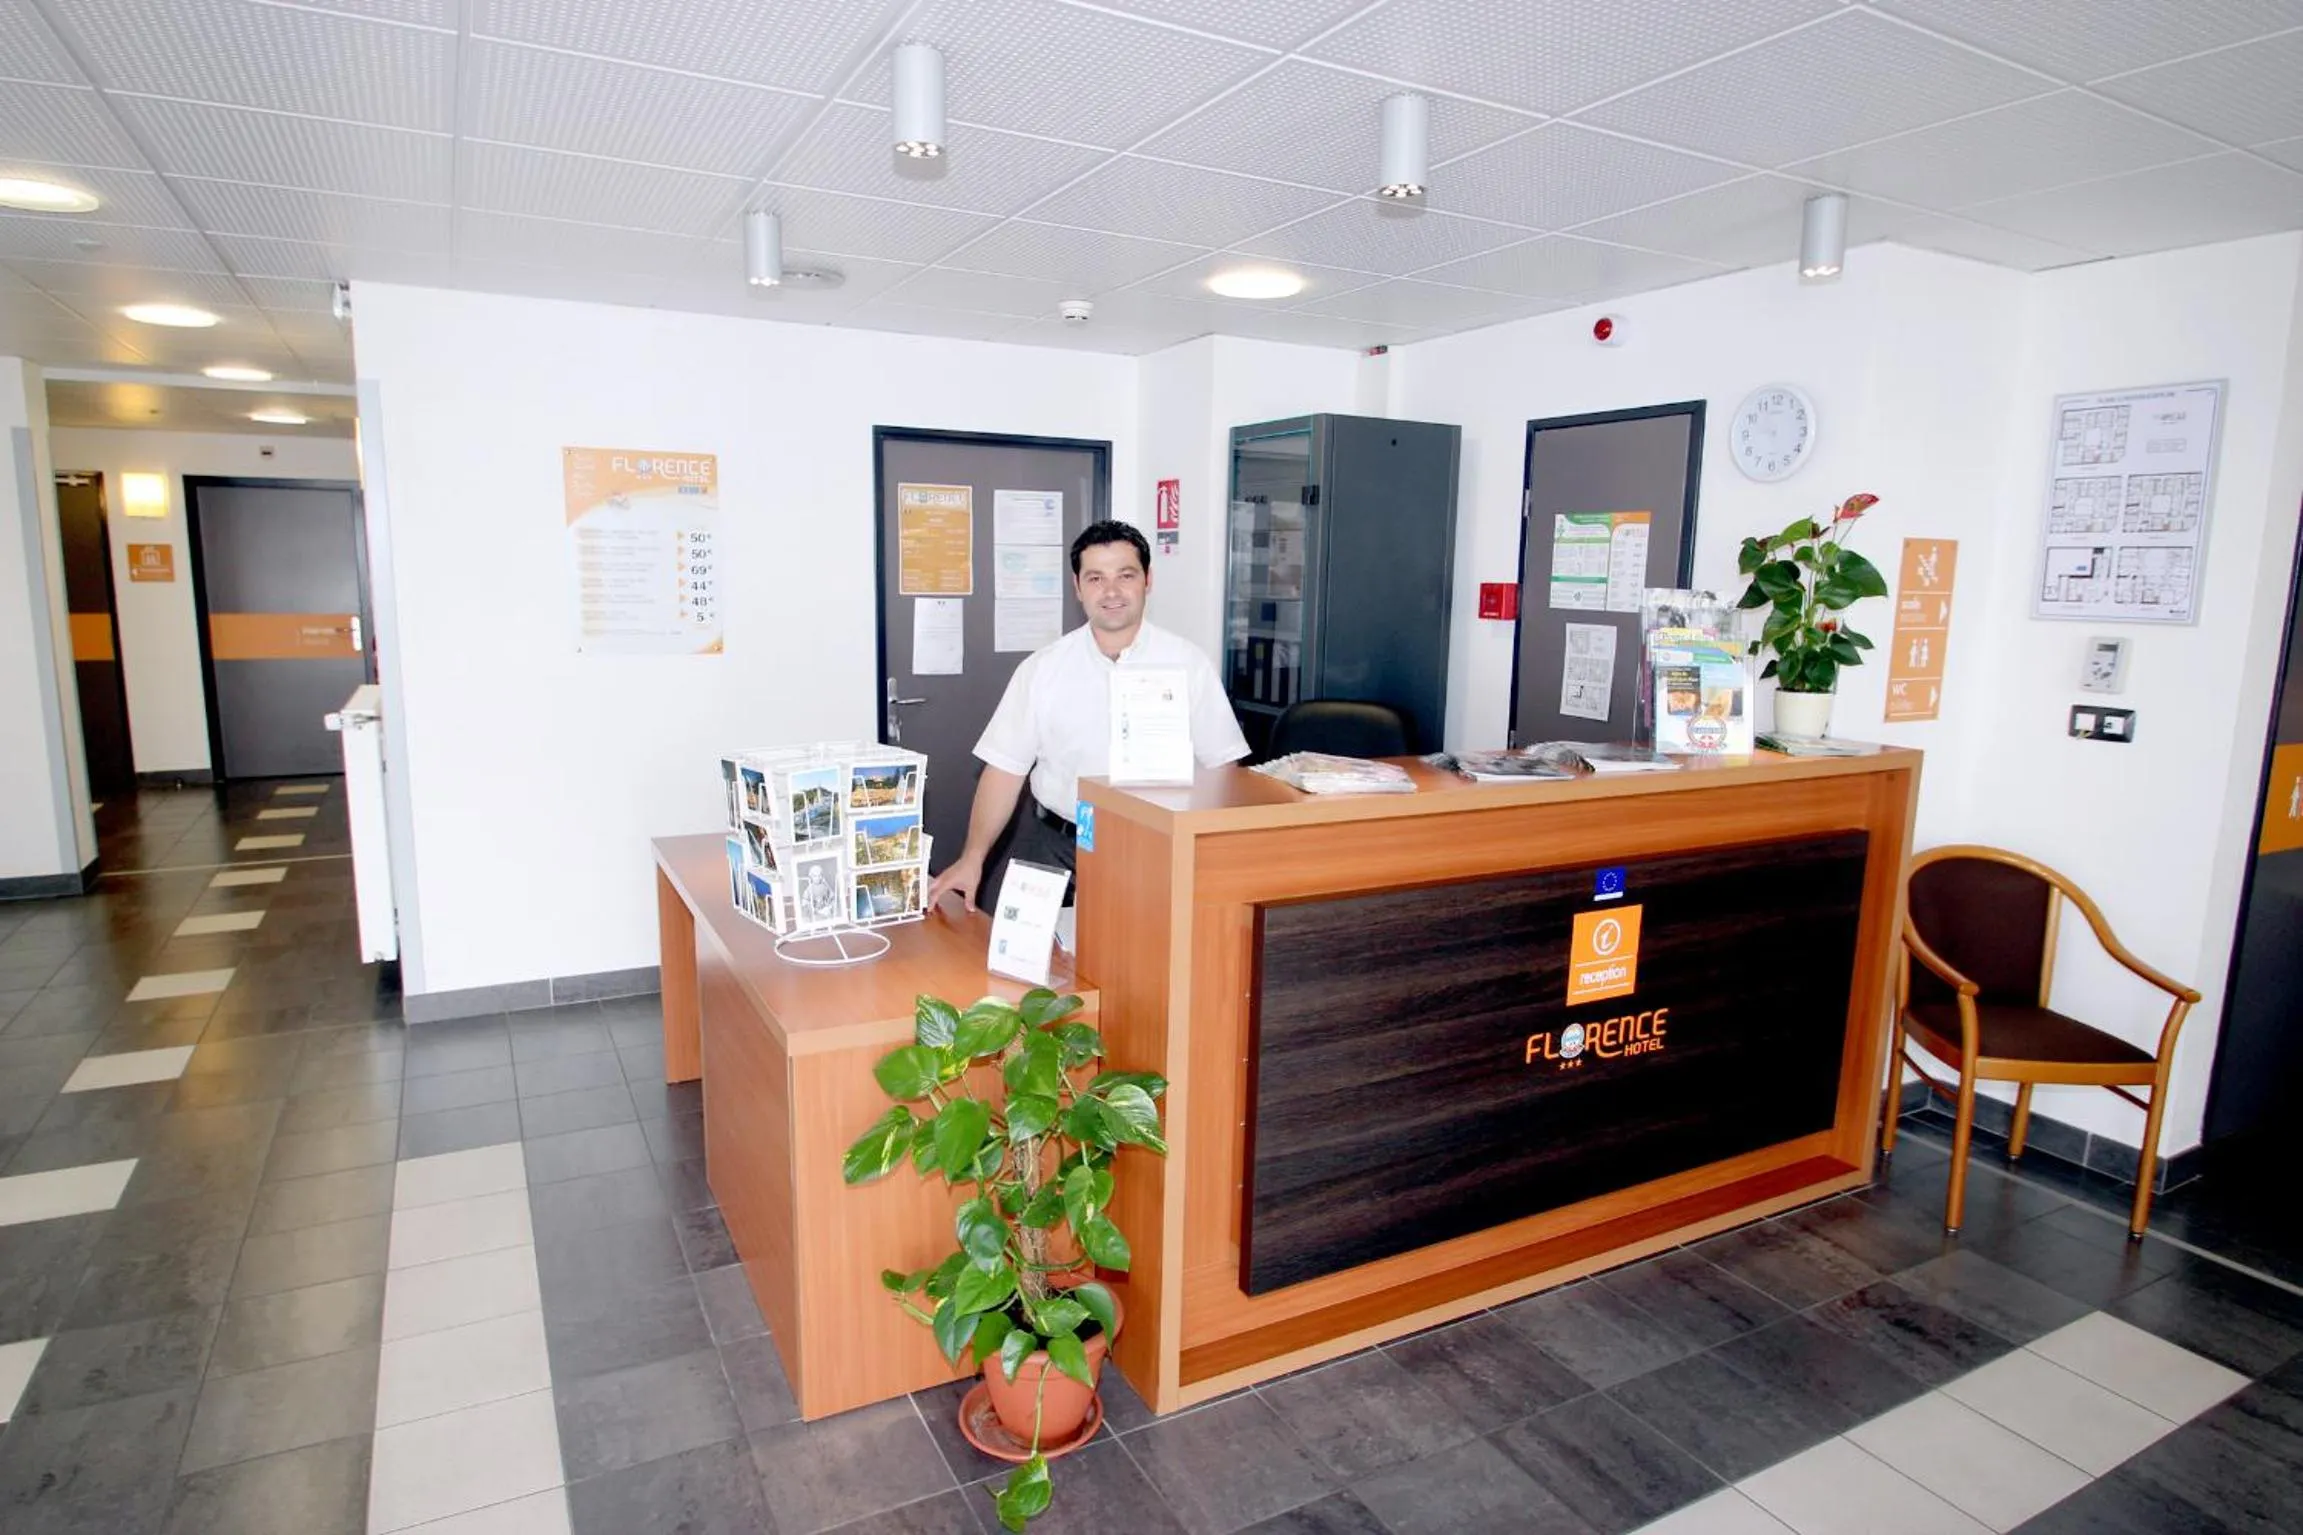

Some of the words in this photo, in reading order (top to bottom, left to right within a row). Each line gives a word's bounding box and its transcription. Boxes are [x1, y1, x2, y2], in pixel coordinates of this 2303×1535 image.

[1757, 399, 1769, 412] 11
[1772, 394, 1783, 405] 12
[1789, 398, 1795, 409] 1
[1796, 408, 1805, 420] 2
[1799, 426, 1807, 437] 3
[1793, 443, 1802, 453] 4
[612, 457, 711, 478] FLORENCE
[1755, 455, 1763, 468] 7
[1768, 460, 1775, 471] 6
[1892, 682, 1907, 697] WC
[1525, 1008, 1669, 1064] FLORENCE
[1624, 1037, 1664, 1057] HOTEL
